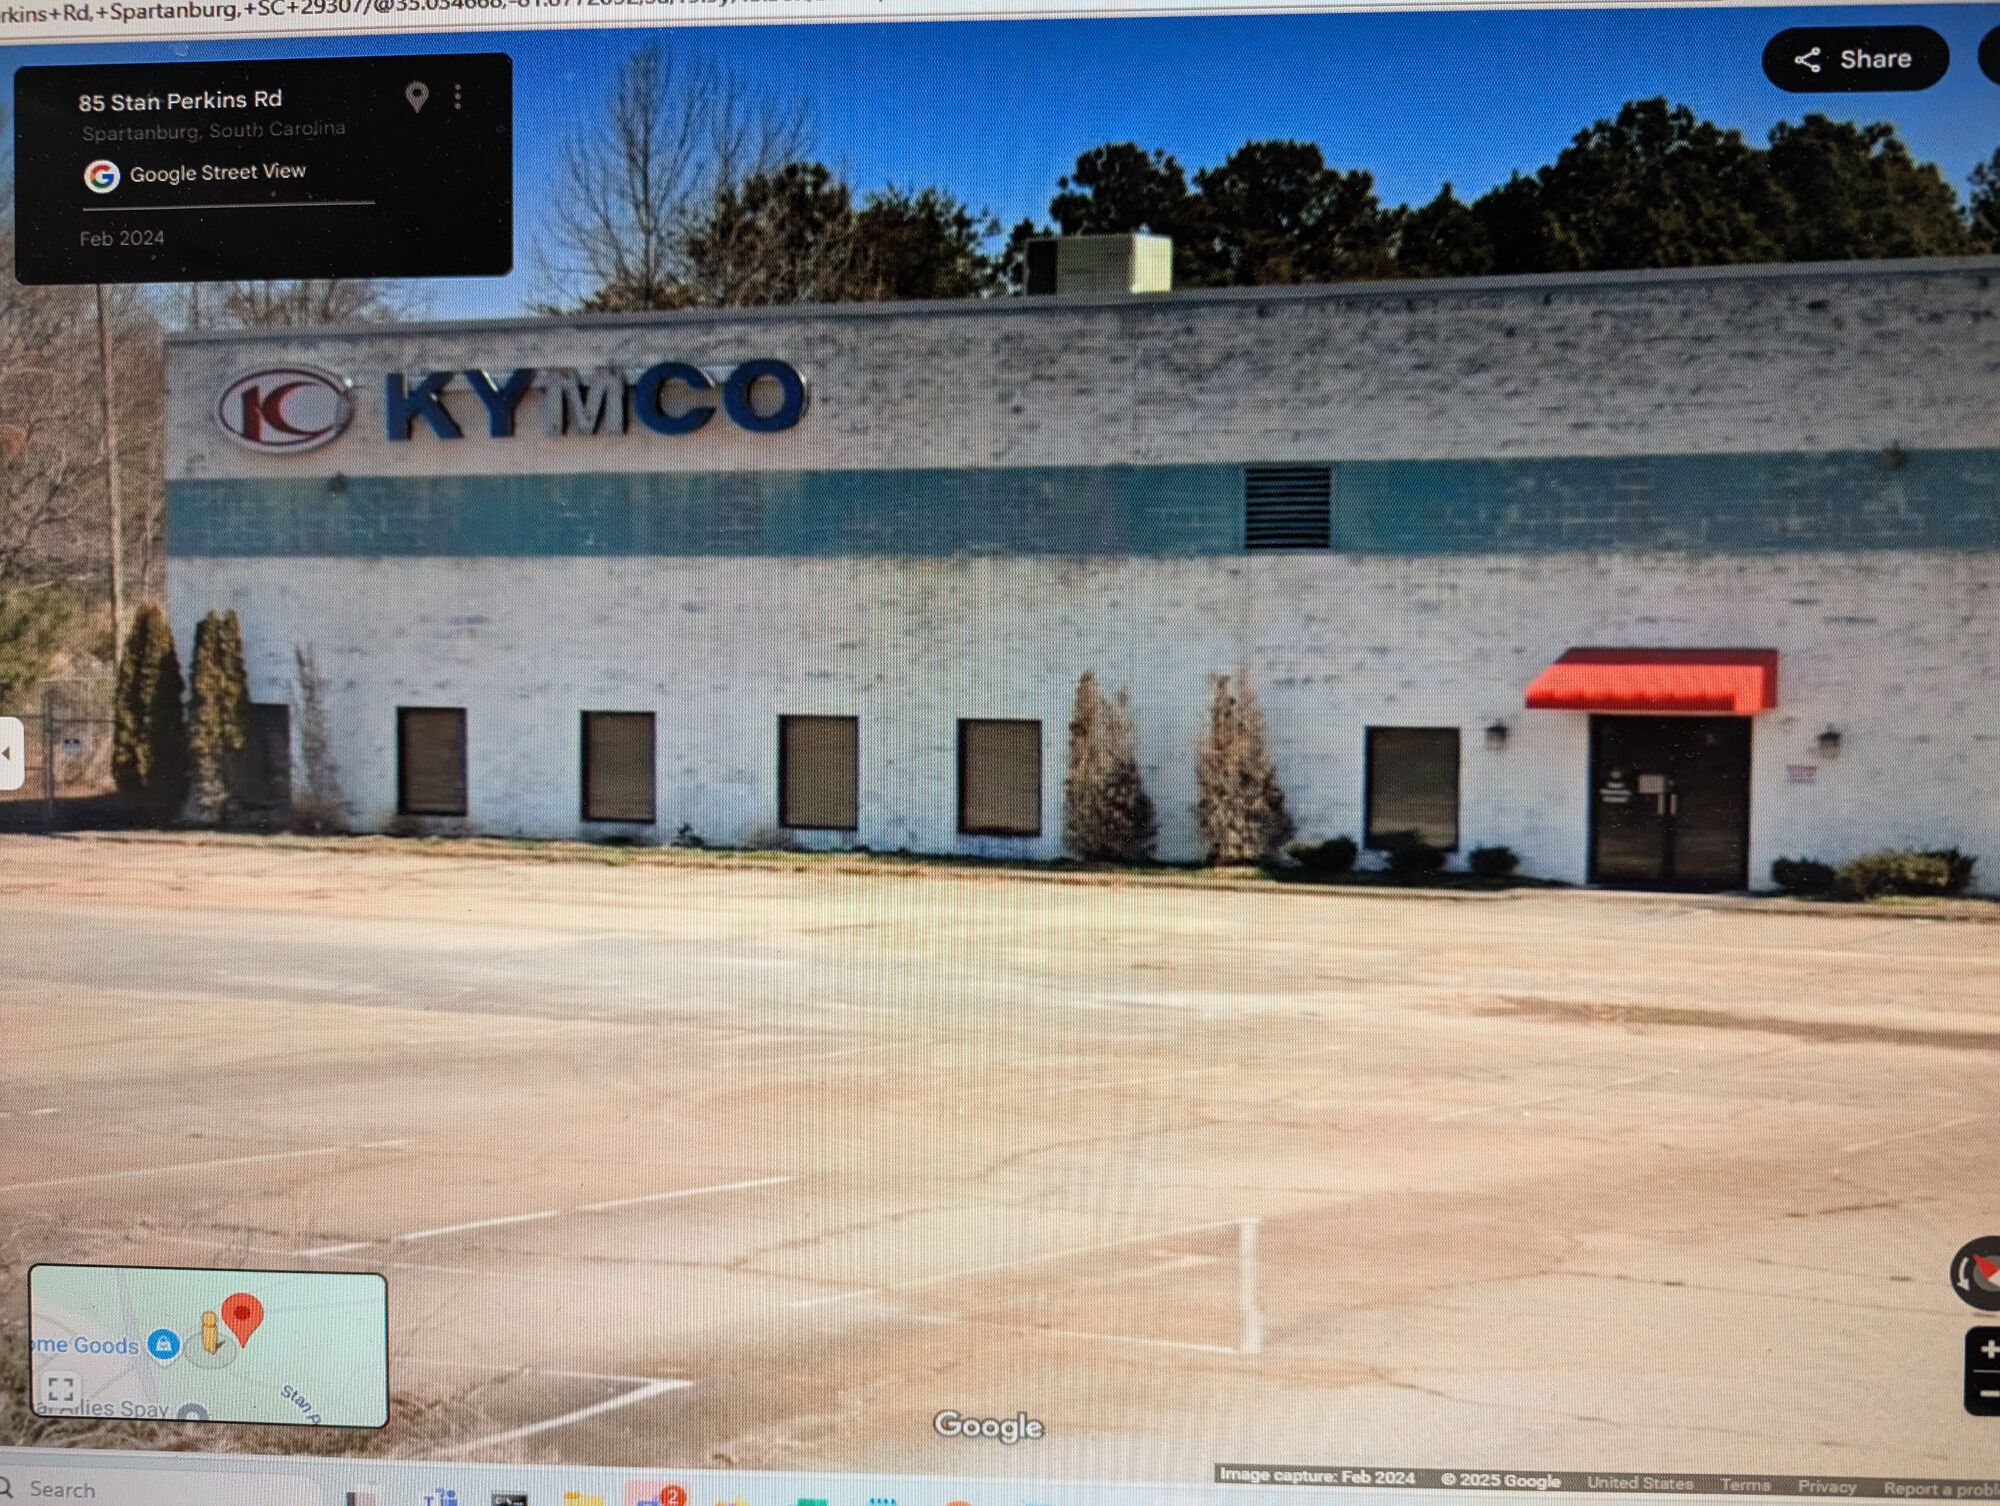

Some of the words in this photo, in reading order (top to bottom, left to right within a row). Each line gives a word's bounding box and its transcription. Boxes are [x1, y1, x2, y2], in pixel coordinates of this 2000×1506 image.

[1840, 48, 1913, 69] Share
[78, 95, 105, 112] 85
[111, 94, 160, 111] Stan
[167, 91, 247, 110] Perkins
[255, 89, 282, 107] Rd
[82, 125, 202, 143] Spartanburg,
[210, 122, 264, 138] South
[269, 119, 346, 137] Carolina
[130, 165, 197, 185] Google
[202, 164, 258, 180] Street
[262, 162, 307, 179] View
[80, 231, 113, 247] Feb
[120, 230, 164, 246] 2024
[386, 358, 808, 442] KYMCO
[74, 1336, 139, 1355] Goods
[280, 1384, 314, 1414] Stan
[935, 1411, 1044, 1445] Google
[1220, 1467, 1270, 1482] Image
[1274, 1470, 1338, 1484] capture:
[1341, 1470, 1371, 1484] Feb
[1375, 1471, 1416, 1485] 2024
[1459, 1473, 1500, 1487] 2025
[1504, 1474, 1562, 1490] Google
[1587, 1476, 1639, 1489] United
[1643, 1477, 1694, 1490] States
[1720, 1478, 1771, 1492] Terms
[30, 1480, 96, 1499] Search
[1799, 1480, 1857, 1495] Privacy
[1884, 1481, 1938, 1498] Report
[1942, 1485, 1951, 1496] a
